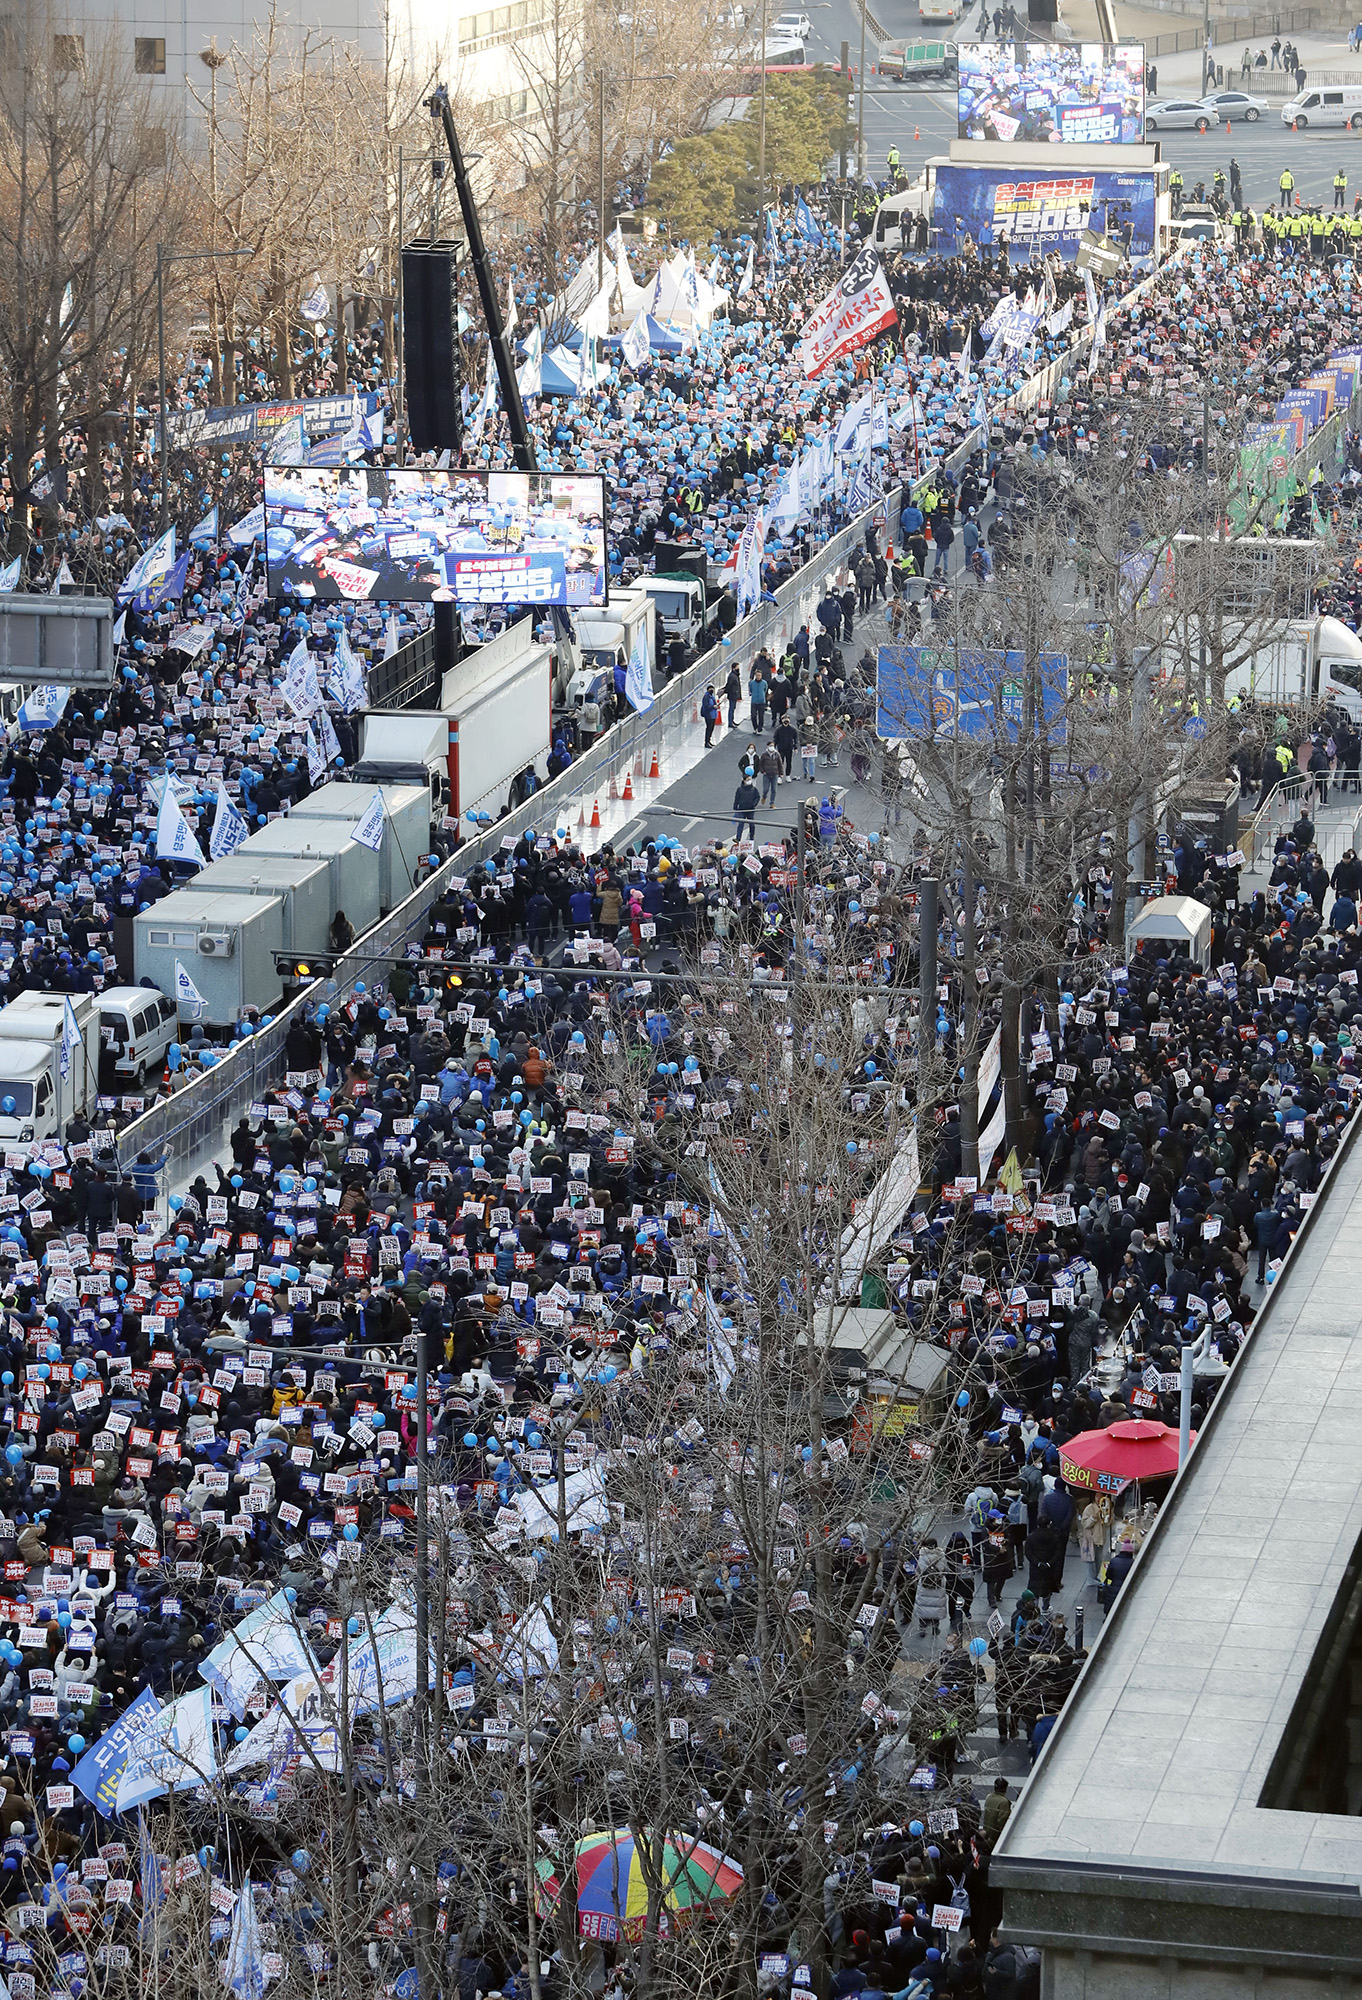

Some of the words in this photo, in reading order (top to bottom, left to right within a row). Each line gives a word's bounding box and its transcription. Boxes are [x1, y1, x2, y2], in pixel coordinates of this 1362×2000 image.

[996, 177, 1095, 203] 윤석열정권
[991, 208, 1091, 236] 규탄대회
[304, 398, 368, 421] 규탄대
[1062, 1462, 1094, 1488] 오징어,
